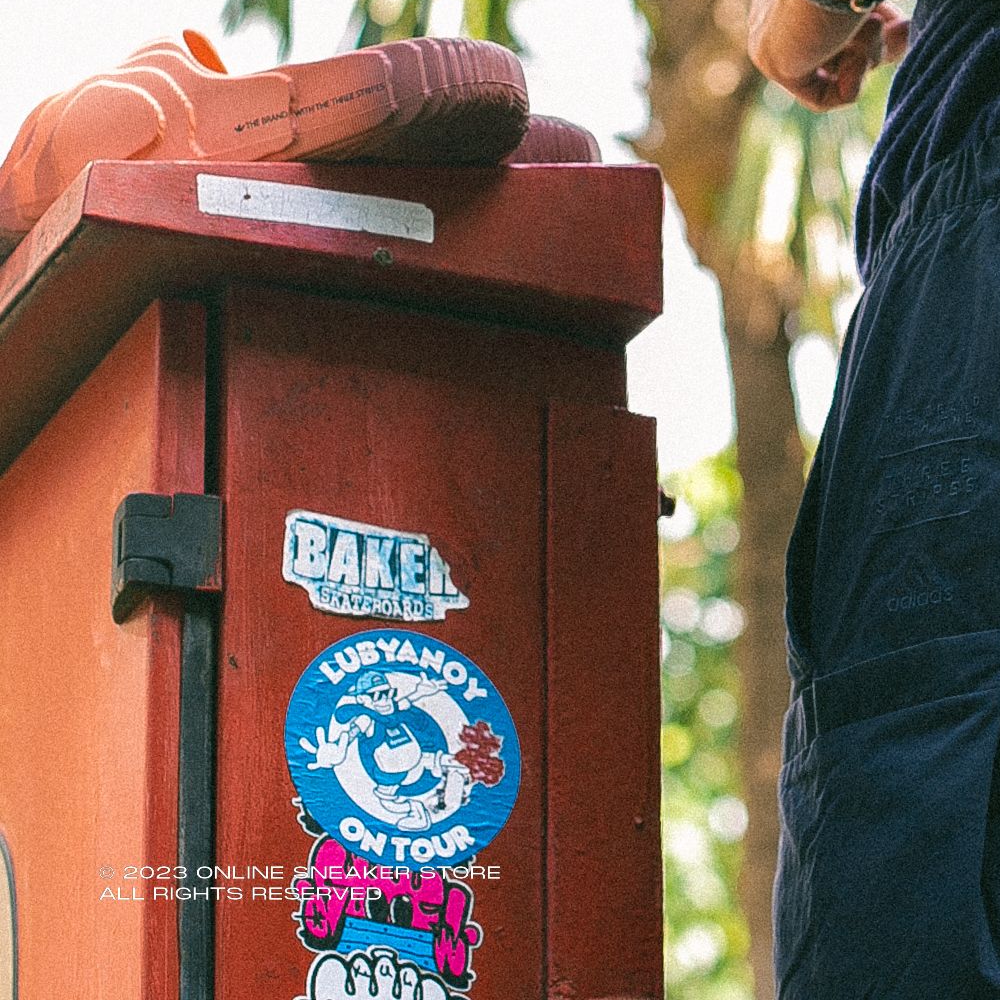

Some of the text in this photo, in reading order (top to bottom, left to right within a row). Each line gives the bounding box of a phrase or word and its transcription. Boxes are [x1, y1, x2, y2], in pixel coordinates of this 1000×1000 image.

[245, 82, 387, 129] THE BRAND WITH THE THREE STRIPES
[318, 637, 488, 702] LUBYANOY
[338, 816, 476, 863] ON TOUR
